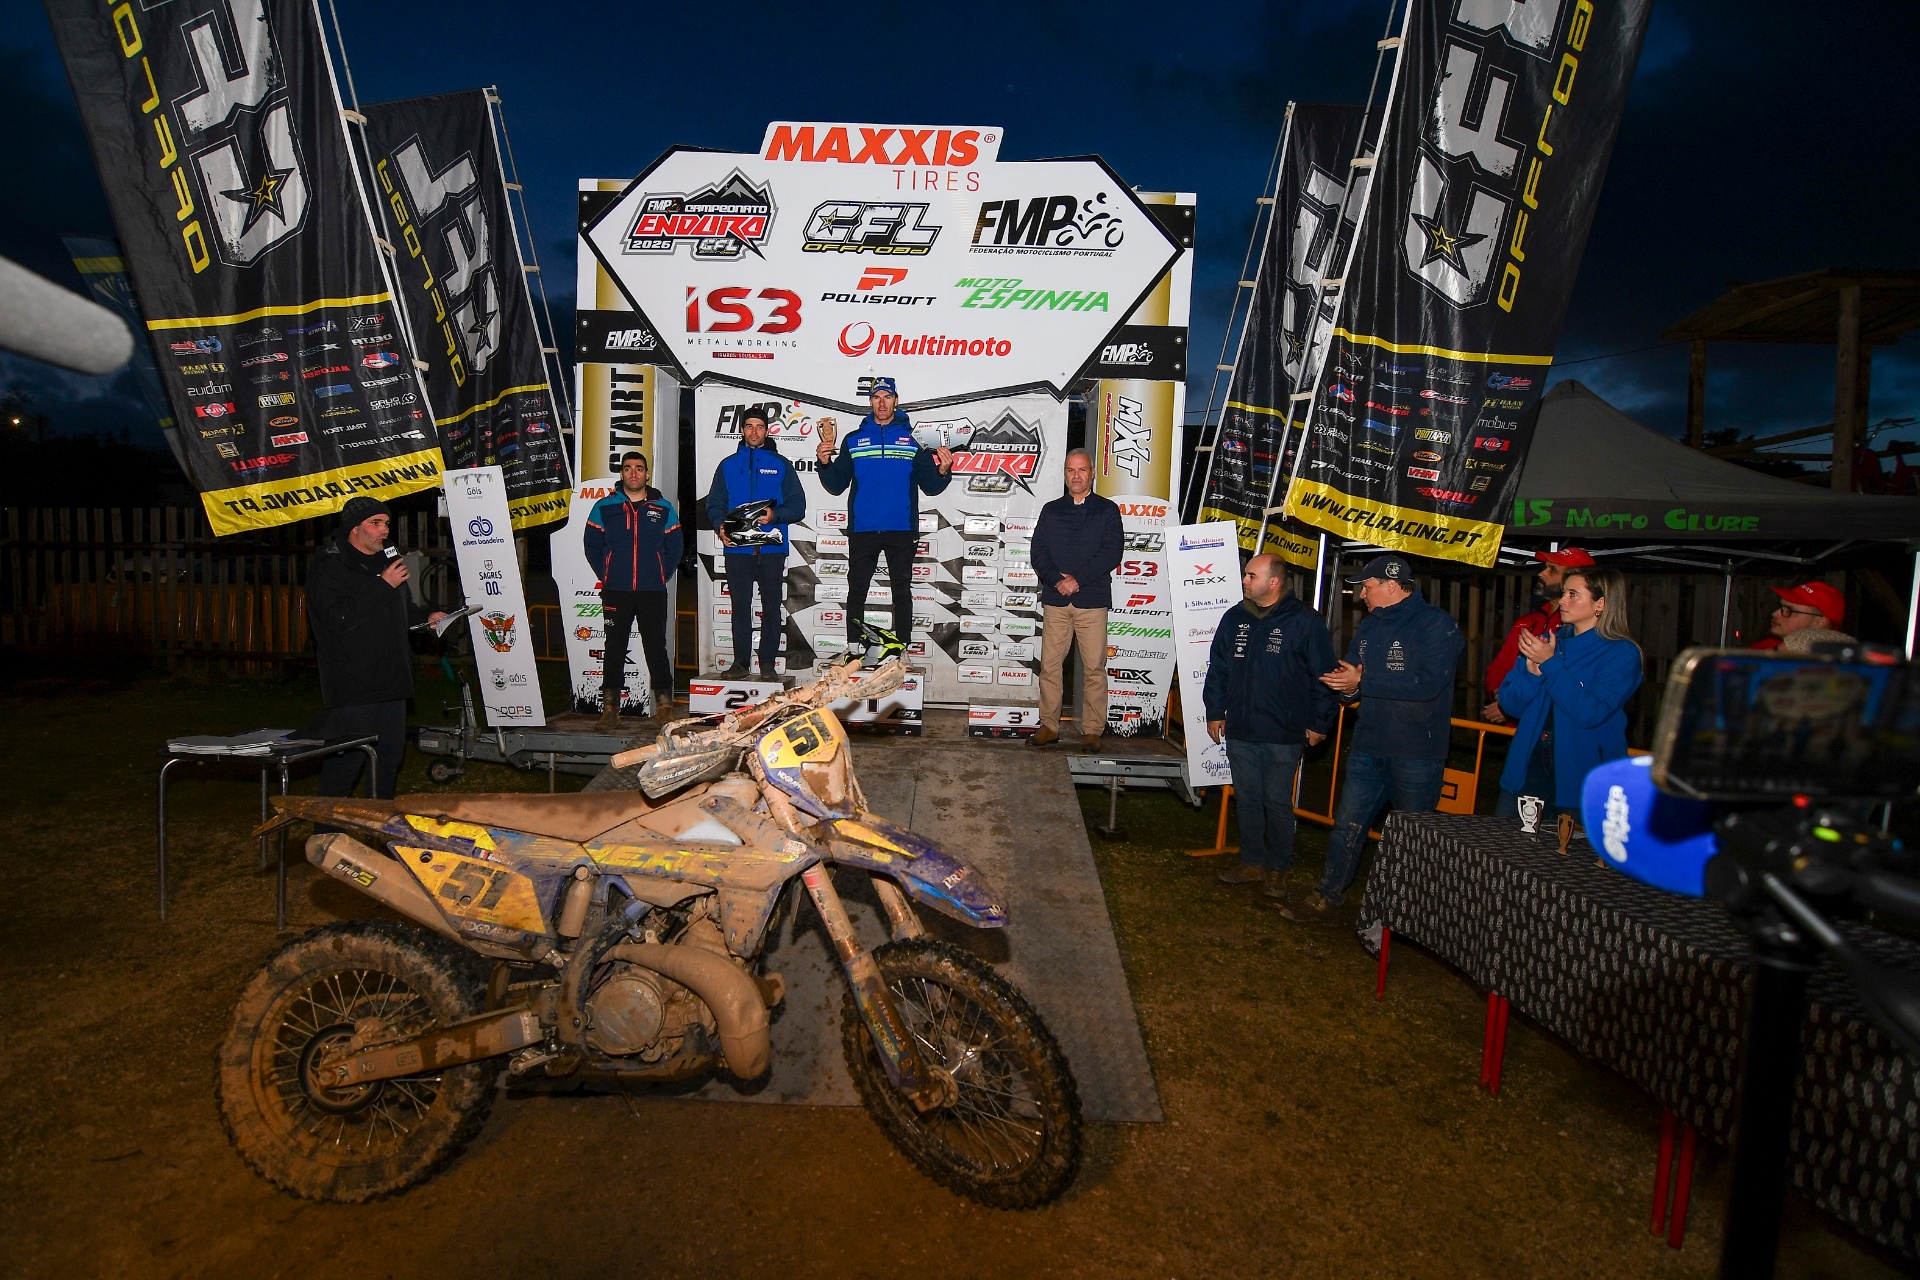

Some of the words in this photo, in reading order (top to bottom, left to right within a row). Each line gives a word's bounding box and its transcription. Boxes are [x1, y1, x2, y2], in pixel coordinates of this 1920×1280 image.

[765, 125, 981, 167] MAXXIS
[893, 169, 980, 192] TIRES
[648, 199, 672, 212] FMP
[803, 200, 943, 247] CFL
[971, 195, 1078, 246] FMP
[633, 214, 768, 246] ENDURO
[969, 247, 1014, 256] FEDERAÇÃO
[1016, 248, 1072, 257] MOTOCICLISMO
[1074, 250, 1113, 258] PORTUGAL
[953, 277, 1023, 289] MOTO
[960, 288, 1109, 312] ESPINHA
[605, 329, 641, 347] FMP
[687, 338, 729, 346] METAL
[736, 339, 797, 348] WORKING
[876, 334, 1012, 357] Multimoto
[1100, 343, 1138, 362] FMP
[969, 442, 1038, 452] MPEONATO
[951, 453, 1037, 475] DURO
[580, 487, 617, 499] MAX
[1118, 503, 1167, 518] AXXIS
[1301, 491, 1483, 548] WWW.CFLRACING.PT
[821, 539, 847, 547] MAXXIS
[479, 570, 502, 581] SAGRES
[912, 566, 931, 576] S3
[1106, 626, 1171, 638] ESPINHA
[1116, 649, 1169, 660] Moto-Master
[509, 672, 527, 683] GÓIS
[1107, 689, 1158, 698] ROSSPRO
[783, 711, 834, 757] 51
[439, 860, 508, 910] 51
